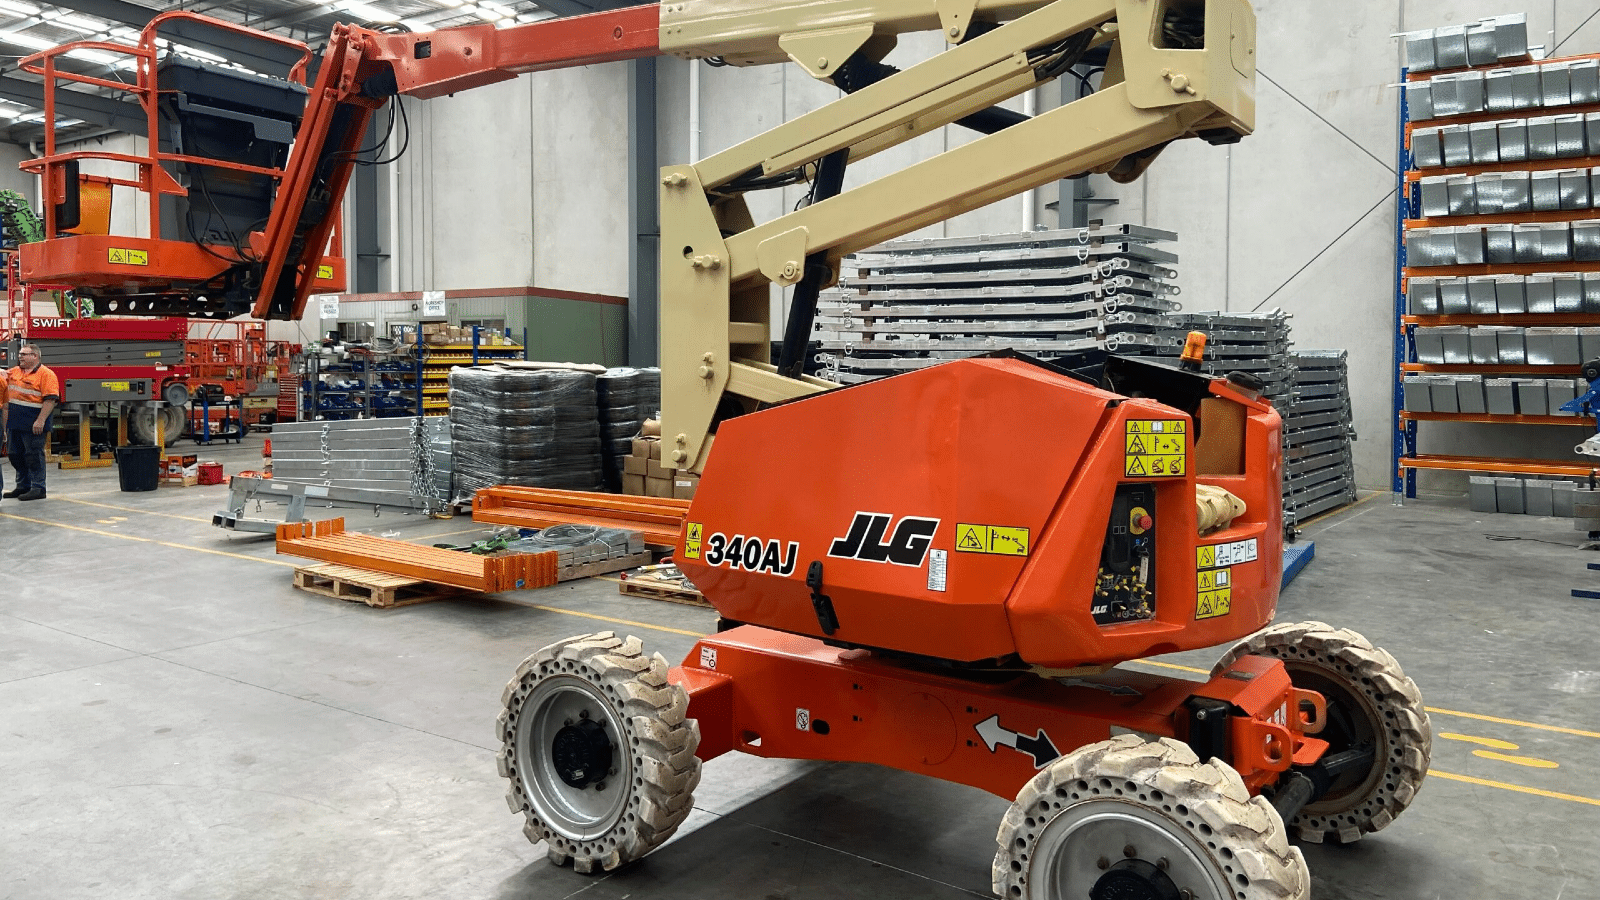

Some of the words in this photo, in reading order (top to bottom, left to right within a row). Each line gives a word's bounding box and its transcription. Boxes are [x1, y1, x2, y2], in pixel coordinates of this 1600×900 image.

[32, 318, 72, 328] SWIFT
[826, 511, 942, 568] JLG
[706, 532, 800, 577] 340AJ
[1090, 604, 1108, 615] JLG
